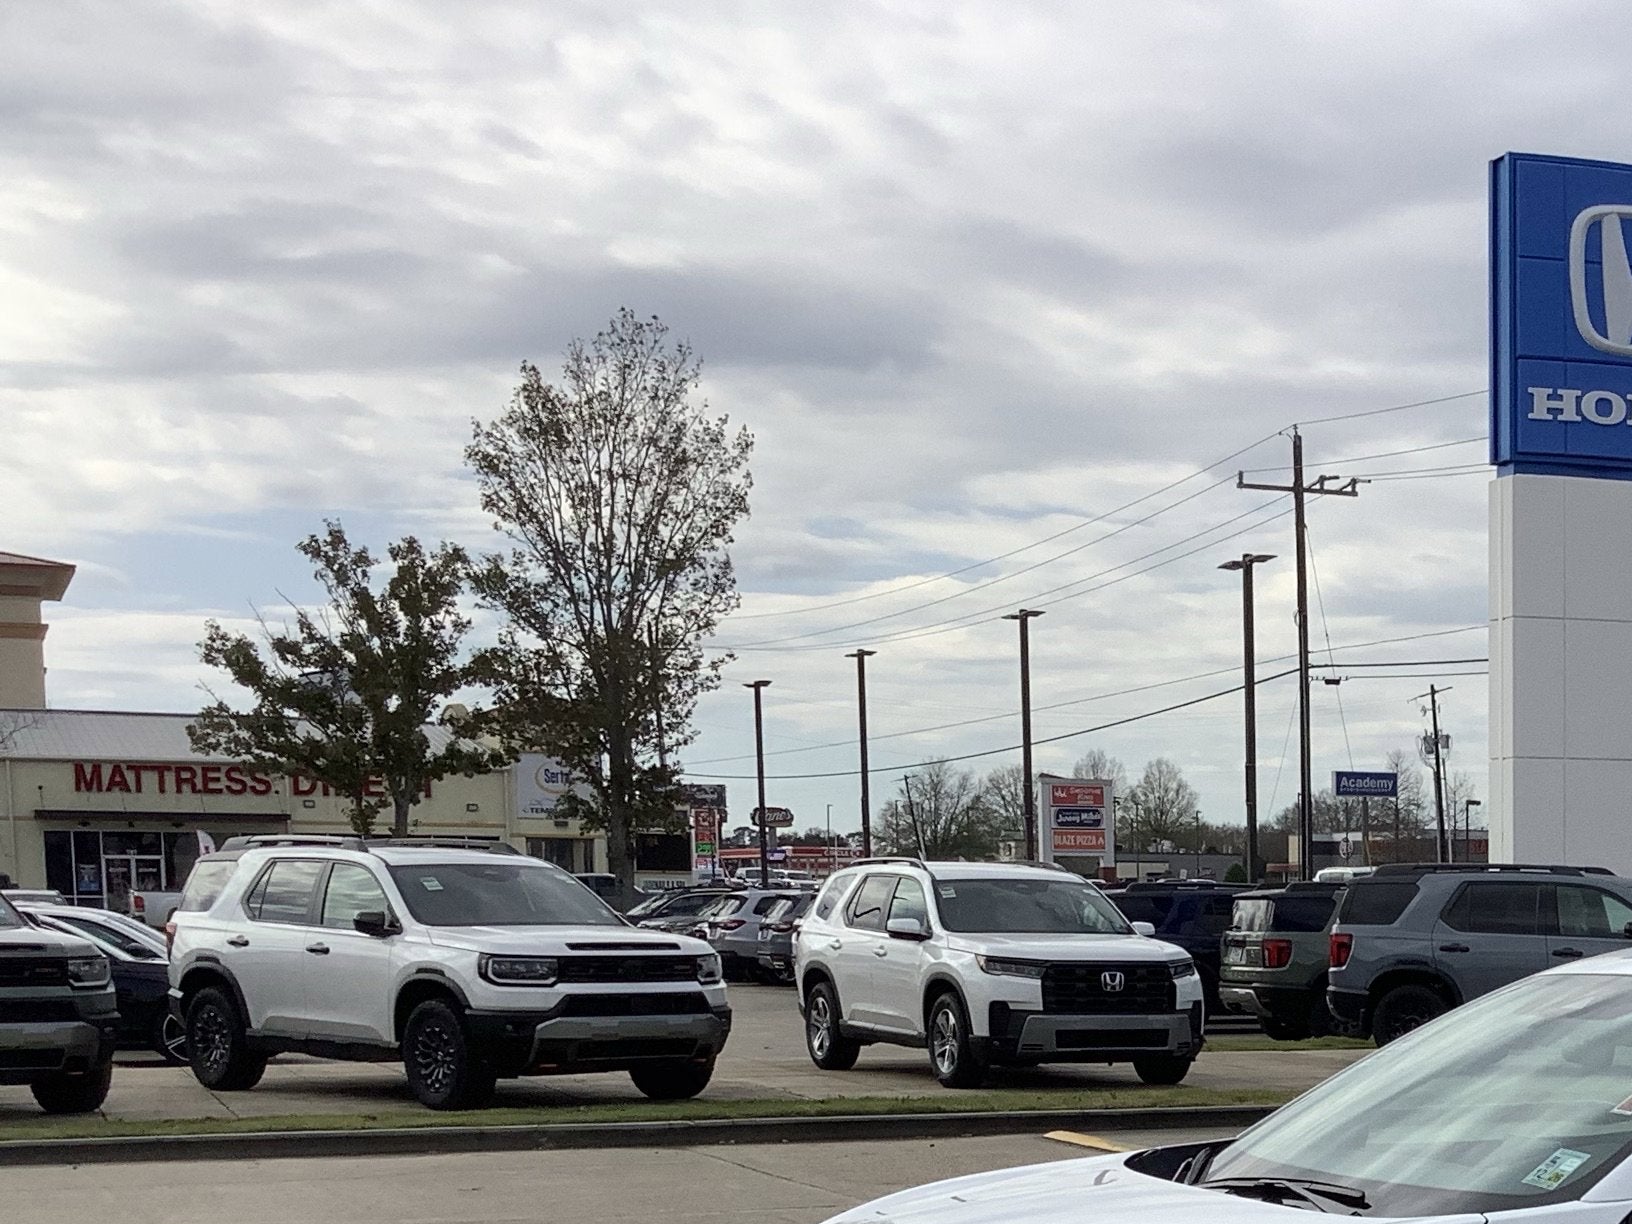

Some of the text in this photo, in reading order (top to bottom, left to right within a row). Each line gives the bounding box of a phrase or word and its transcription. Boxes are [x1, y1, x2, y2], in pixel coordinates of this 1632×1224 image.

[73, 763, 272, 796] MATTRESS
[1340, 777, 1393, 790] Academy
[1054, 835, 1097, 846] BLAZE PIZZA
